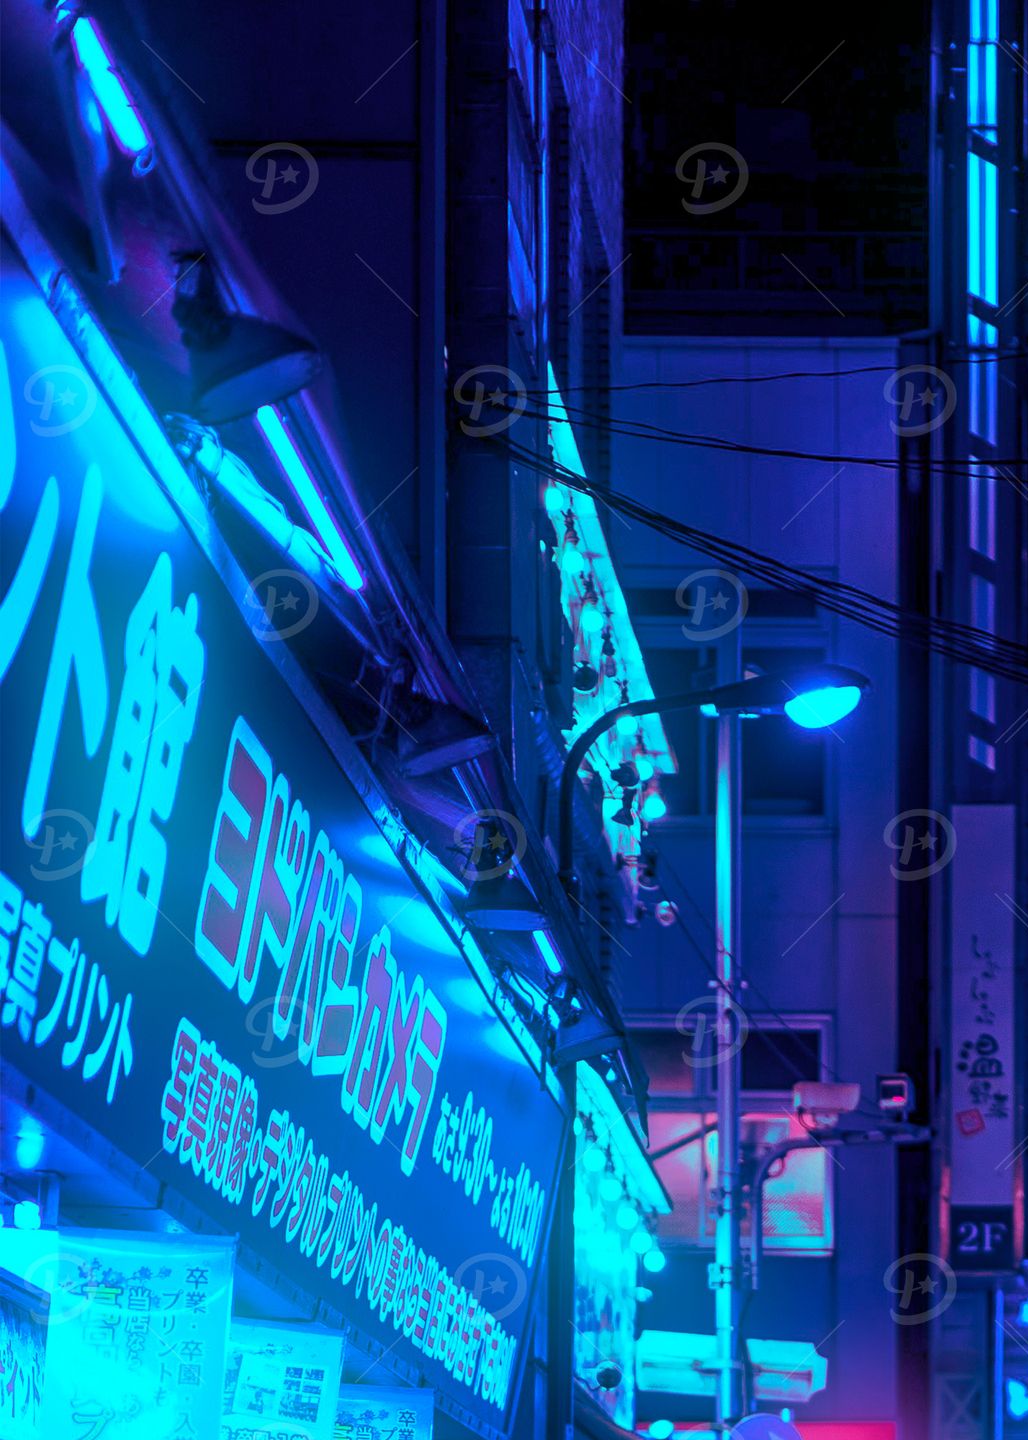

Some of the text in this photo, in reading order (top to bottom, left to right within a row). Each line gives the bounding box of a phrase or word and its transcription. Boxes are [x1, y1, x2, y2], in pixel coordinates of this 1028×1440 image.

[195, 715, 448, 1176] ヨドバシカメラ
[957, 1222, 1008, 1253] 2F
